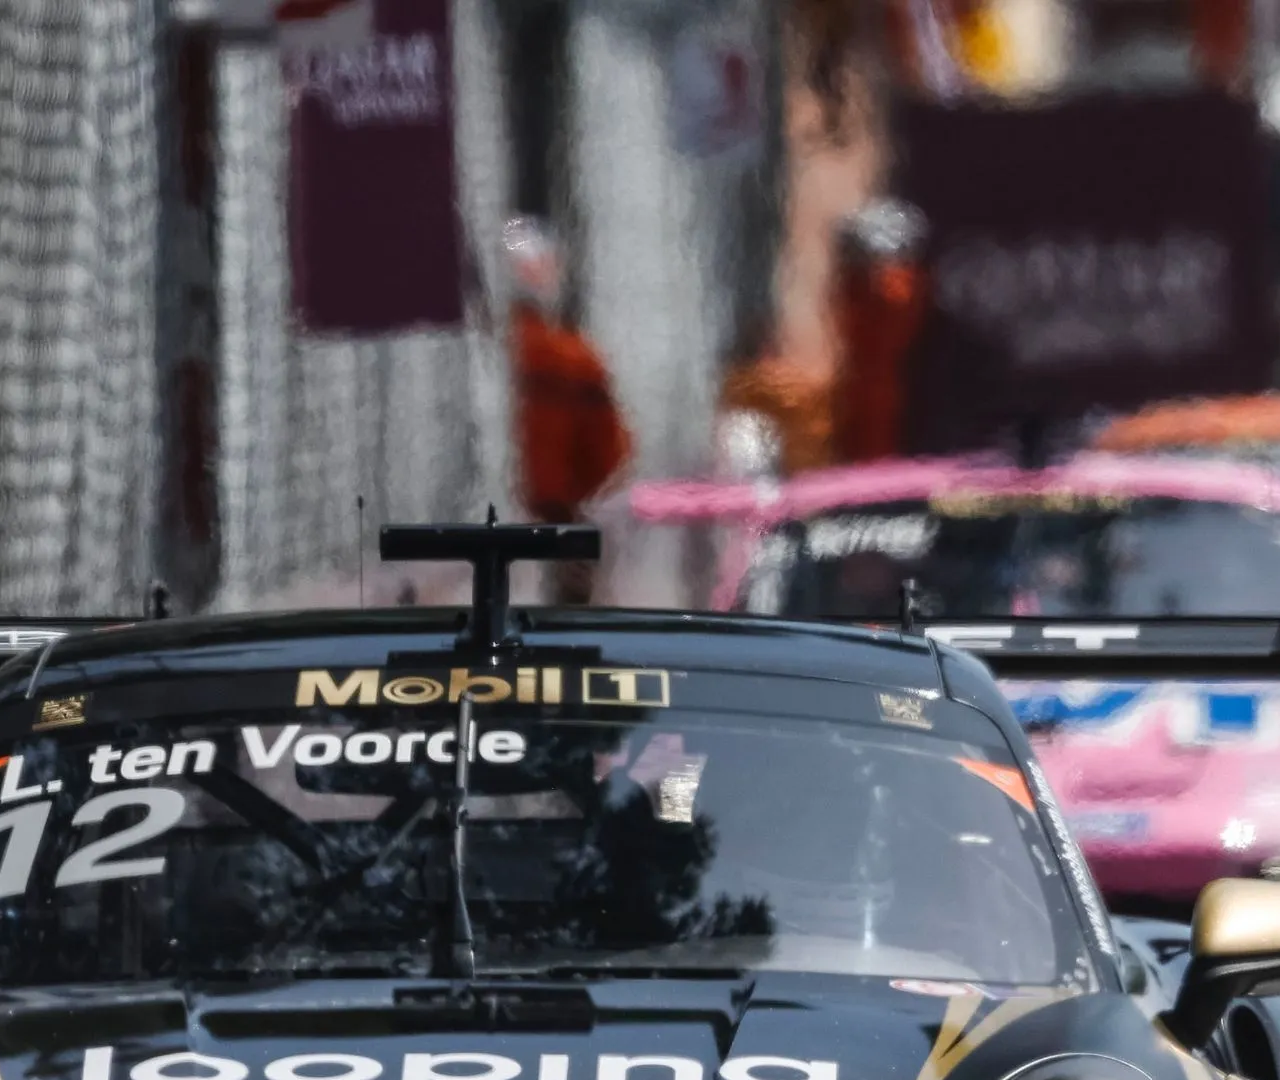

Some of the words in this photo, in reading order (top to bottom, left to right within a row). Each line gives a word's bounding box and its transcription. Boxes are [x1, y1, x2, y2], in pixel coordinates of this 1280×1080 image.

[295, 667, 563, 708] Mobil
[0, 754, 62, 804] L.
[87, 742, 217, 784] ten
[240, 724, 527, 770] Voorde
